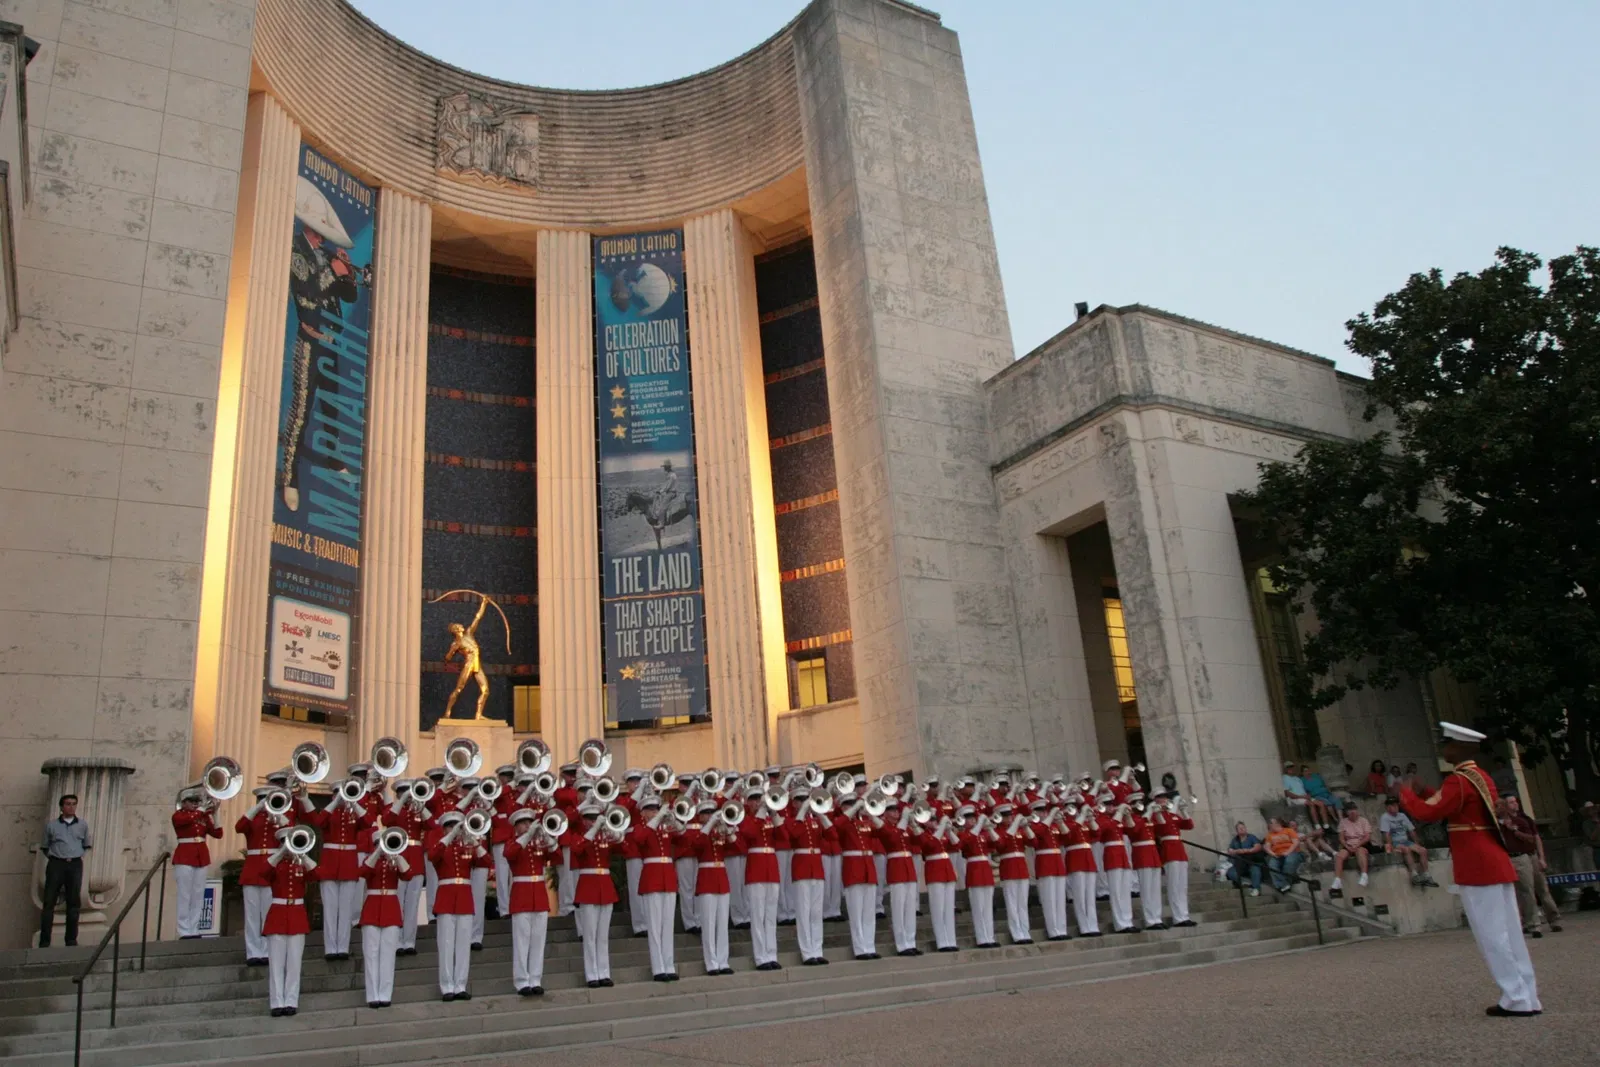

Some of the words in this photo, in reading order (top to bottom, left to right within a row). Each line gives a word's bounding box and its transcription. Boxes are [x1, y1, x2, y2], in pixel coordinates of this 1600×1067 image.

[305, 150, 338, 186] MUNDO
[341, 173, 371, 208] LATINO
[601, 237, 637, 257] MUNDO
[641, 233, 677, 252] LATINO
[605, 318, 680, 352] CELEBRATION
[606, 351, 620, 379] OF
[623, 345, 681, 377] CULTURES
[630, 380, 670, 389] EDUCATION
[630, 386, 668, 395] PROGRAMS
[657, 405, 685, 413] EXHIBIT
[307, 308, 369, 541] MARIACHI
[631, 419, 666, 427] MERCADO
[1212, 425, 1244, 449] SAM
[271, 522, 302, 550] MUSIC
[303, 533, 312, 554] &
[313, 535, 359, 569] TRADITION
[286, 572, 310, 586] FREE
[612, 556, 644, 595] THE
[648, 552, 692, 592] LAND
[294, 609, 334, 626] ExxonMobil
[615, 600, 643, 630] THAT
[647, 597, 694, 626] SHAPED
[318, 629, 342, 642] LNESC
[615, 629, 640, 658] THE
[643, 624, 696, 656] PEOPLE
[640, 673, 680, 682] HERITAGE
